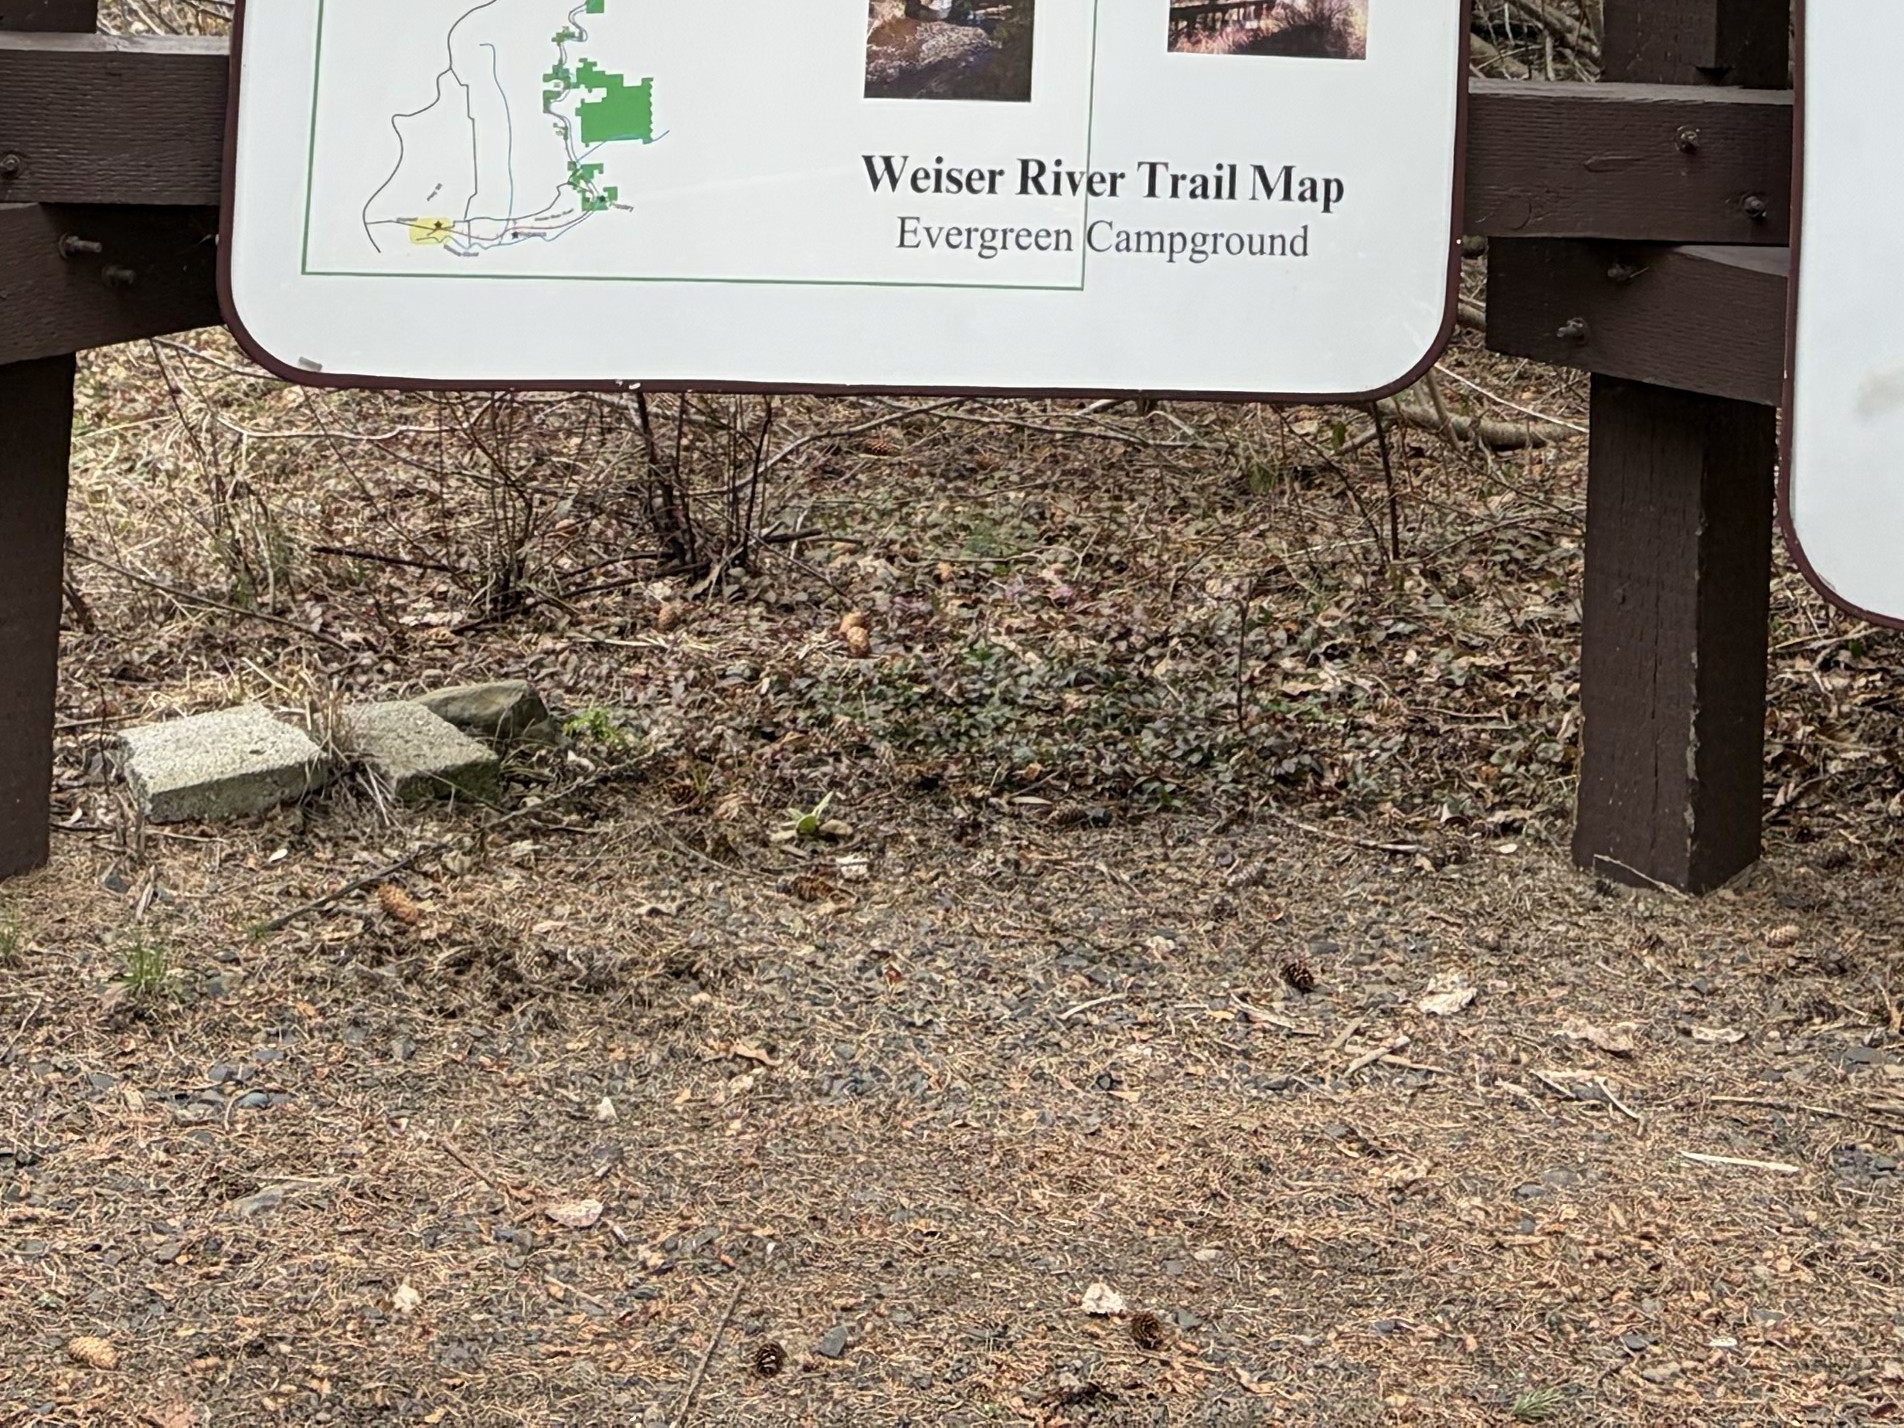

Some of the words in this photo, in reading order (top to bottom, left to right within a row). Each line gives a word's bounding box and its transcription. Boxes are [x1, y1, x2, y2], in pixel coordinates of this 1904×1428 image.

[861, 155, 1004, 194] Weiser
[1016, 158, 1126, 198] River
[1137, 161, 1236, 199] Trail
[1249, 164, 1343, 212] Map
[896, 216, 1072, 258] Evergreen
[1086, 220, 1308, 262] Campground
